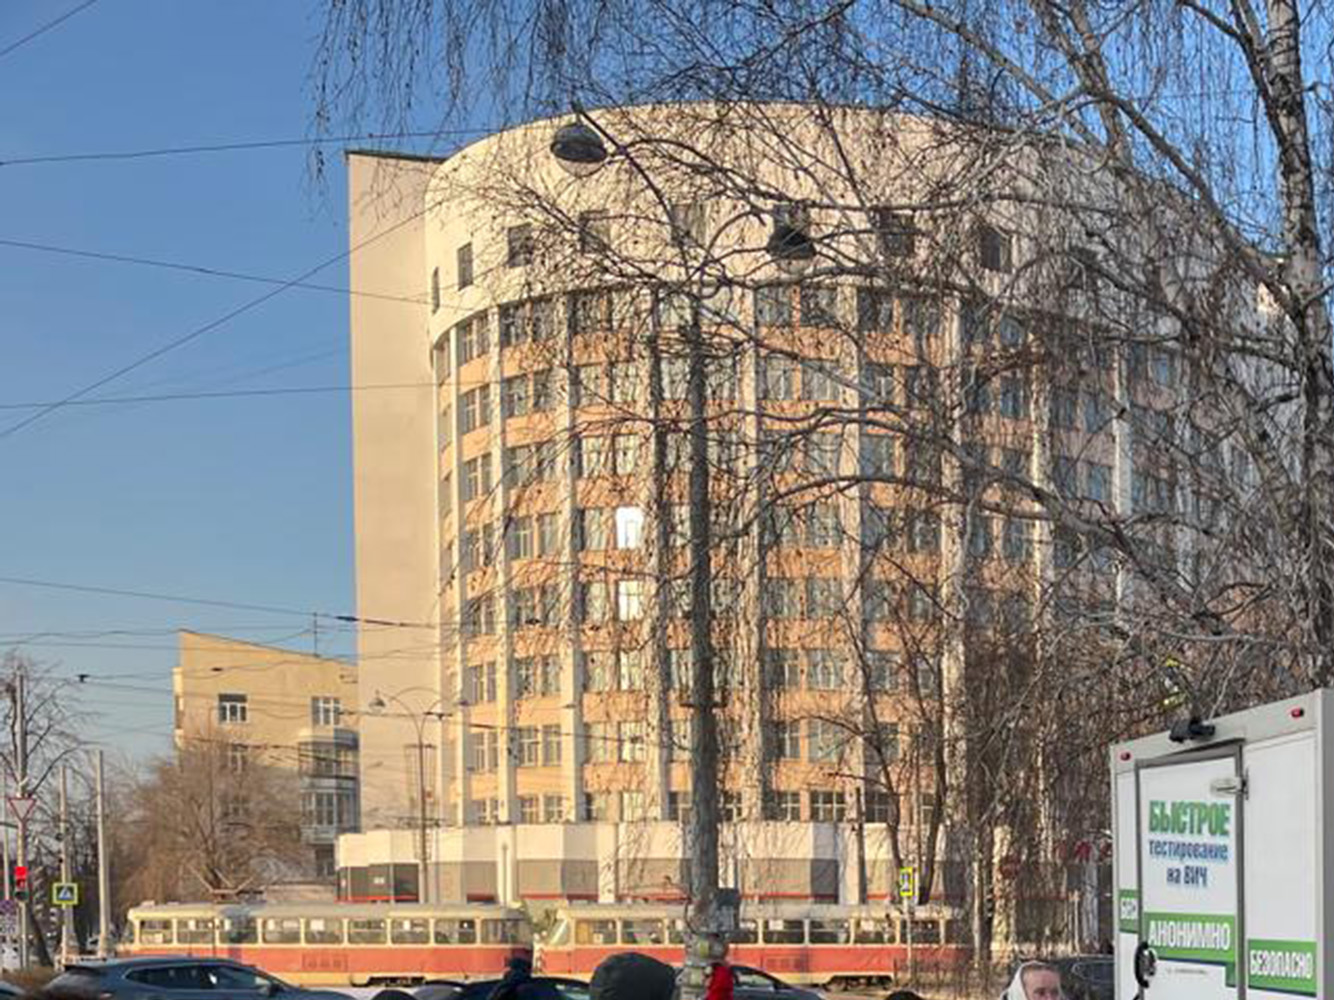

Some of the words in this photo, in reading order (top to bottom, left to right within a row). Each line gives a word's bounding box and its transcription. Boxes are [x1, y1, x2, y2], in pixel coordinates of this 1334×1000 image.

[1148, 800, 1231, 836] БЫСТРОЕ
[1148, 839, 1229, 861] тестирование
[1166, 866, 1181, 885] на
[1184, 865, 1209, 887] ВИЧ
[1147, 920, 1231, 951] АНОНИМНО
[1249, 949, 1314, 979] БЕЗОПАСНО
